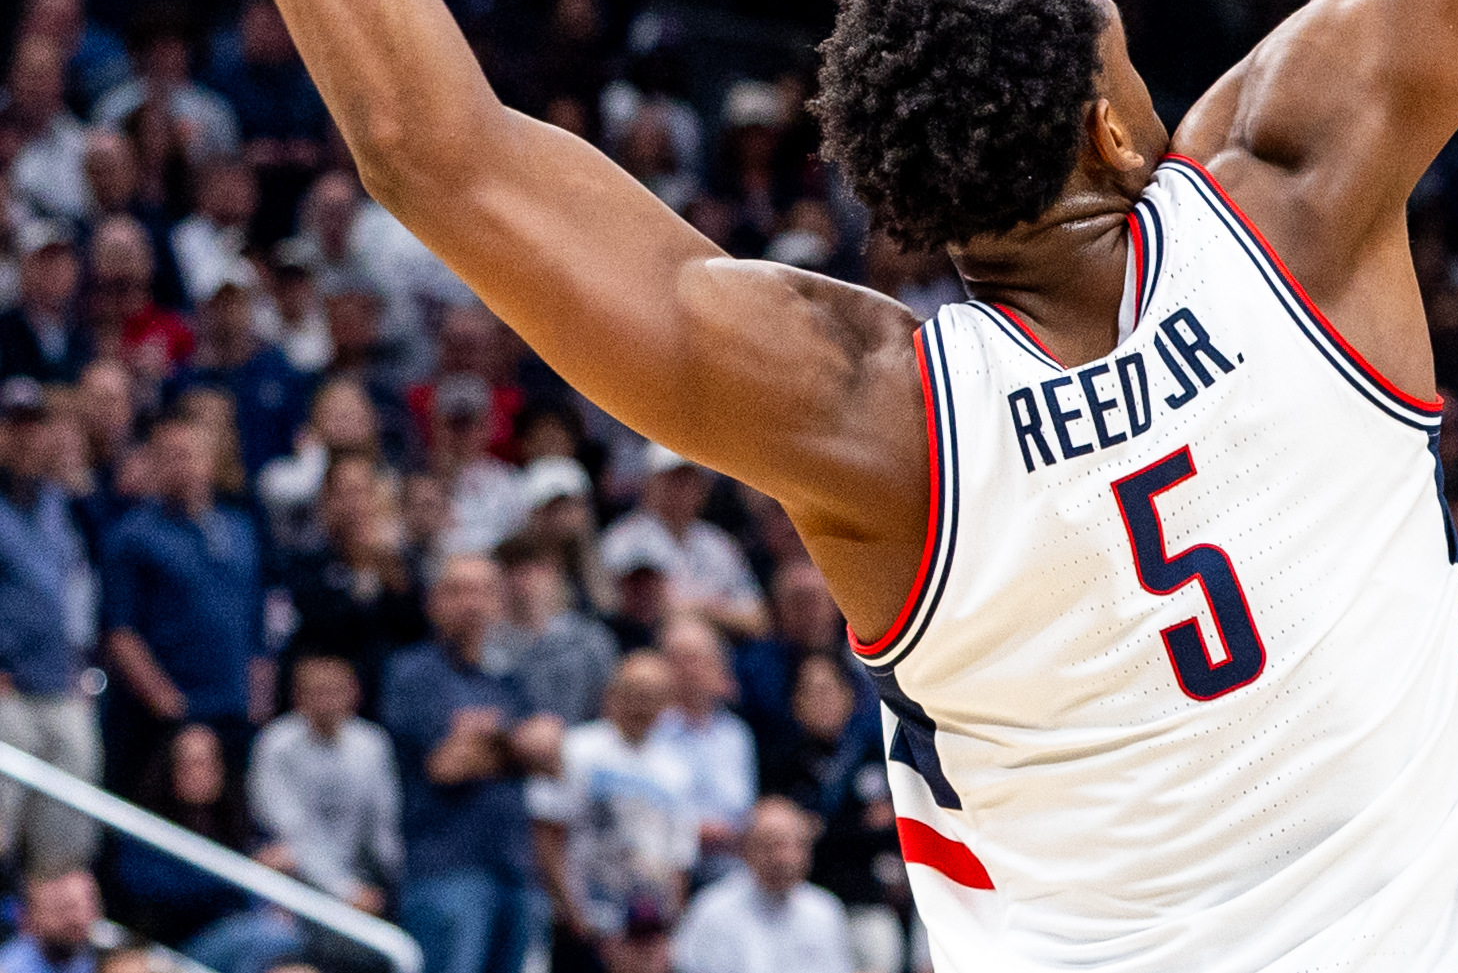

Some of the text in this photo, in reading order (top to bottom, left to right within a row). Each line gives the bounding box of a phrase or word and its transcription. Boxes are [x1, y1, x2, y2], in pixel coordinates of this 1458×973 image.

[1007, 306, 1245, 473] REED JR.
[1110, 444, 1267, 702] 5
